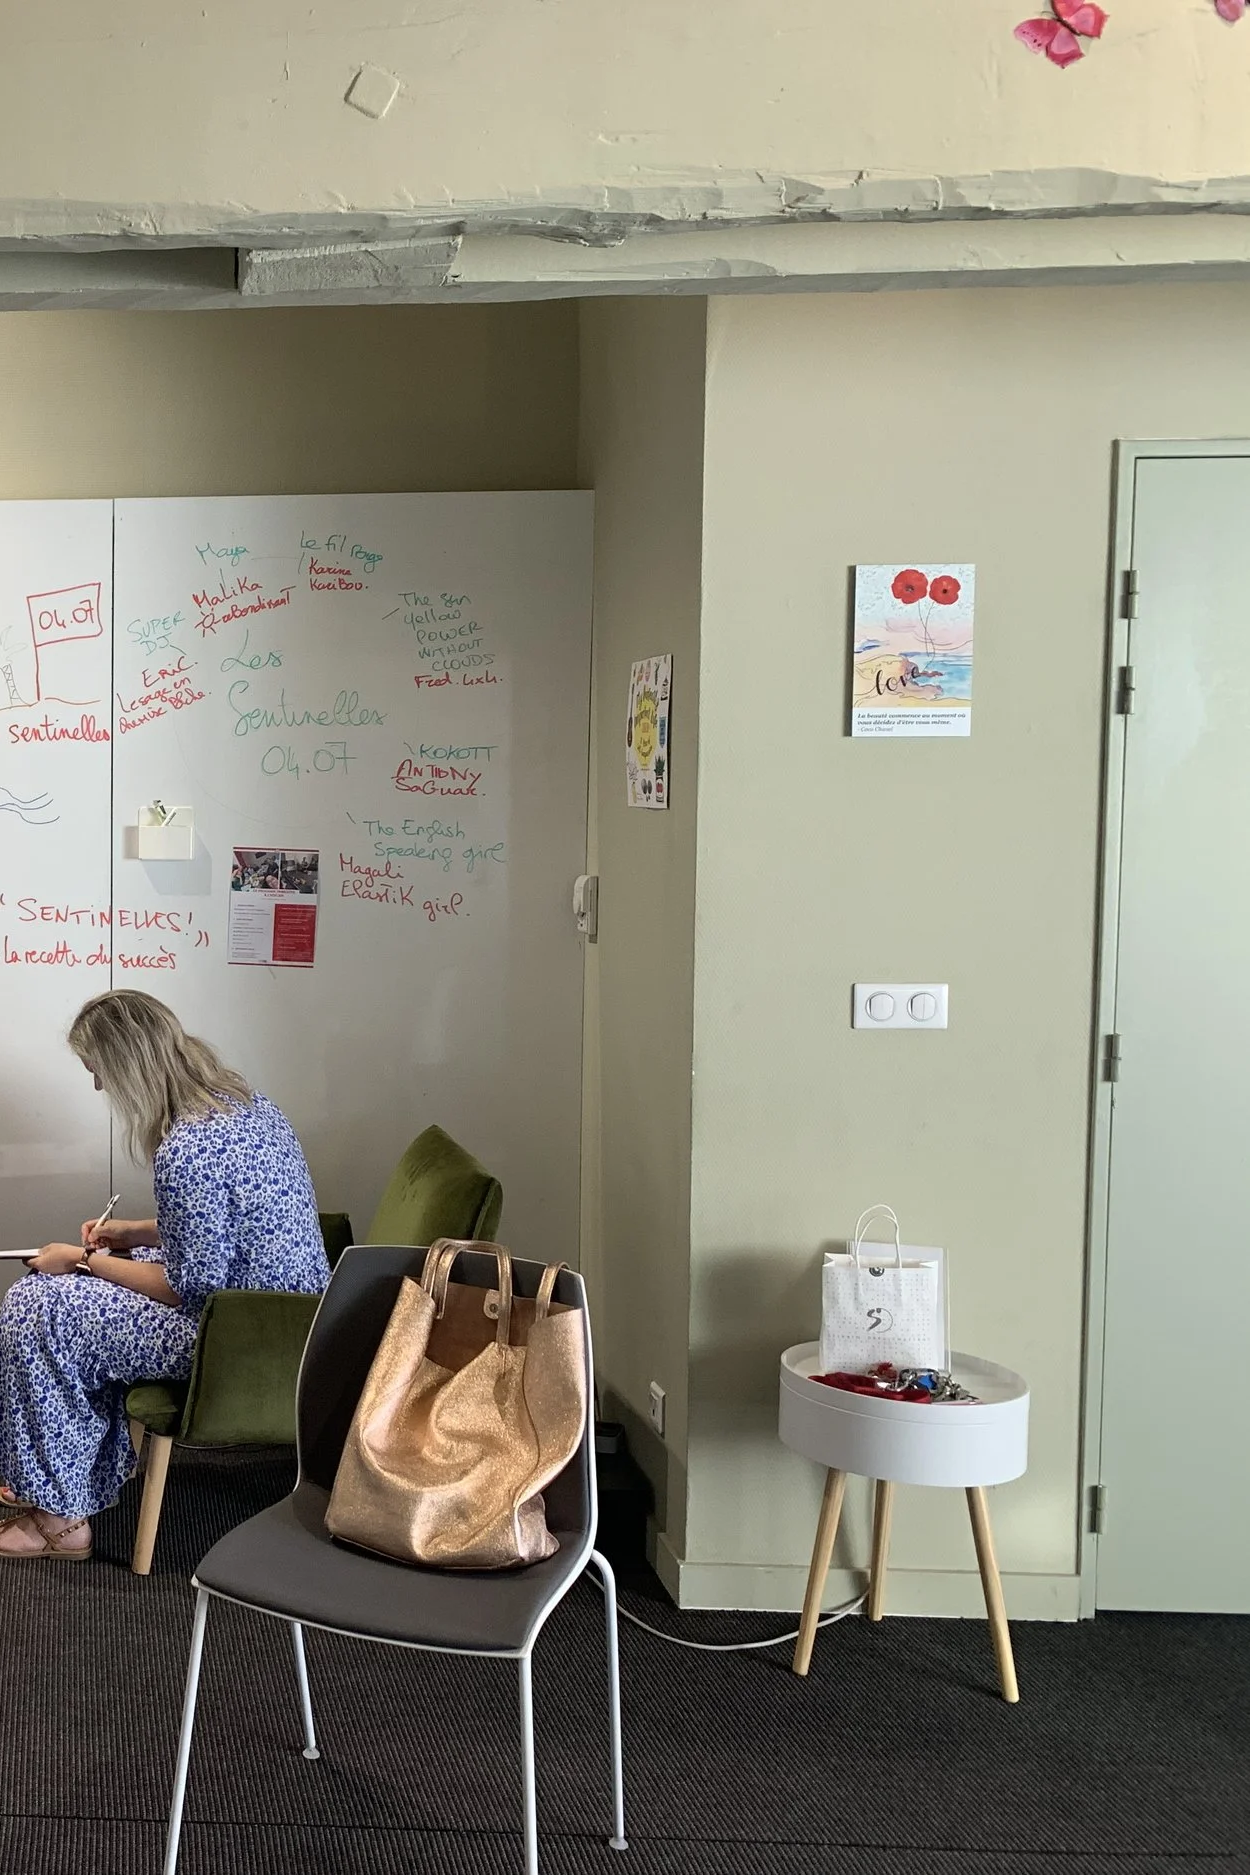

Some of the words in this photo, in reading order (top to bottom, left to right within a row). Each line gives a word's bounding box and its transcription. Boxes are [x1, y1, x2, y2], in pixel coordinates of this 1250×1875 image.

[196, 542, 250, 567] Maya
[326, 535, 346, 552] fil
[308, 556, 352, 576] Karine
[398, 592, 432, 607] The
[127, 610, 186, 642] SUPER
[416, 621, 484, 645] POWER
[140, 632, 172, 656] DJ
[220, 630, 282, 673] Les
[419, 638, 484, 659] WITHOUT
[432, 654, 496, 672] CLOUDS
[174, 677, 192, 689] en
[876, 666, 920, 696] love
[227, 680, 388, 736] Sentinelles
[8, 714, 110, 744] sentinelles
[260, 742, 358, 781] 04.07
[420, 744, 499, 762] KOKOTT
[362, 820, 398, 837] The
[402, 820, 465, 843] English
[462, 842, 506, 873] girl
[340, 852, 404, 888] Magali
[118, 946, 176, 969] succès
